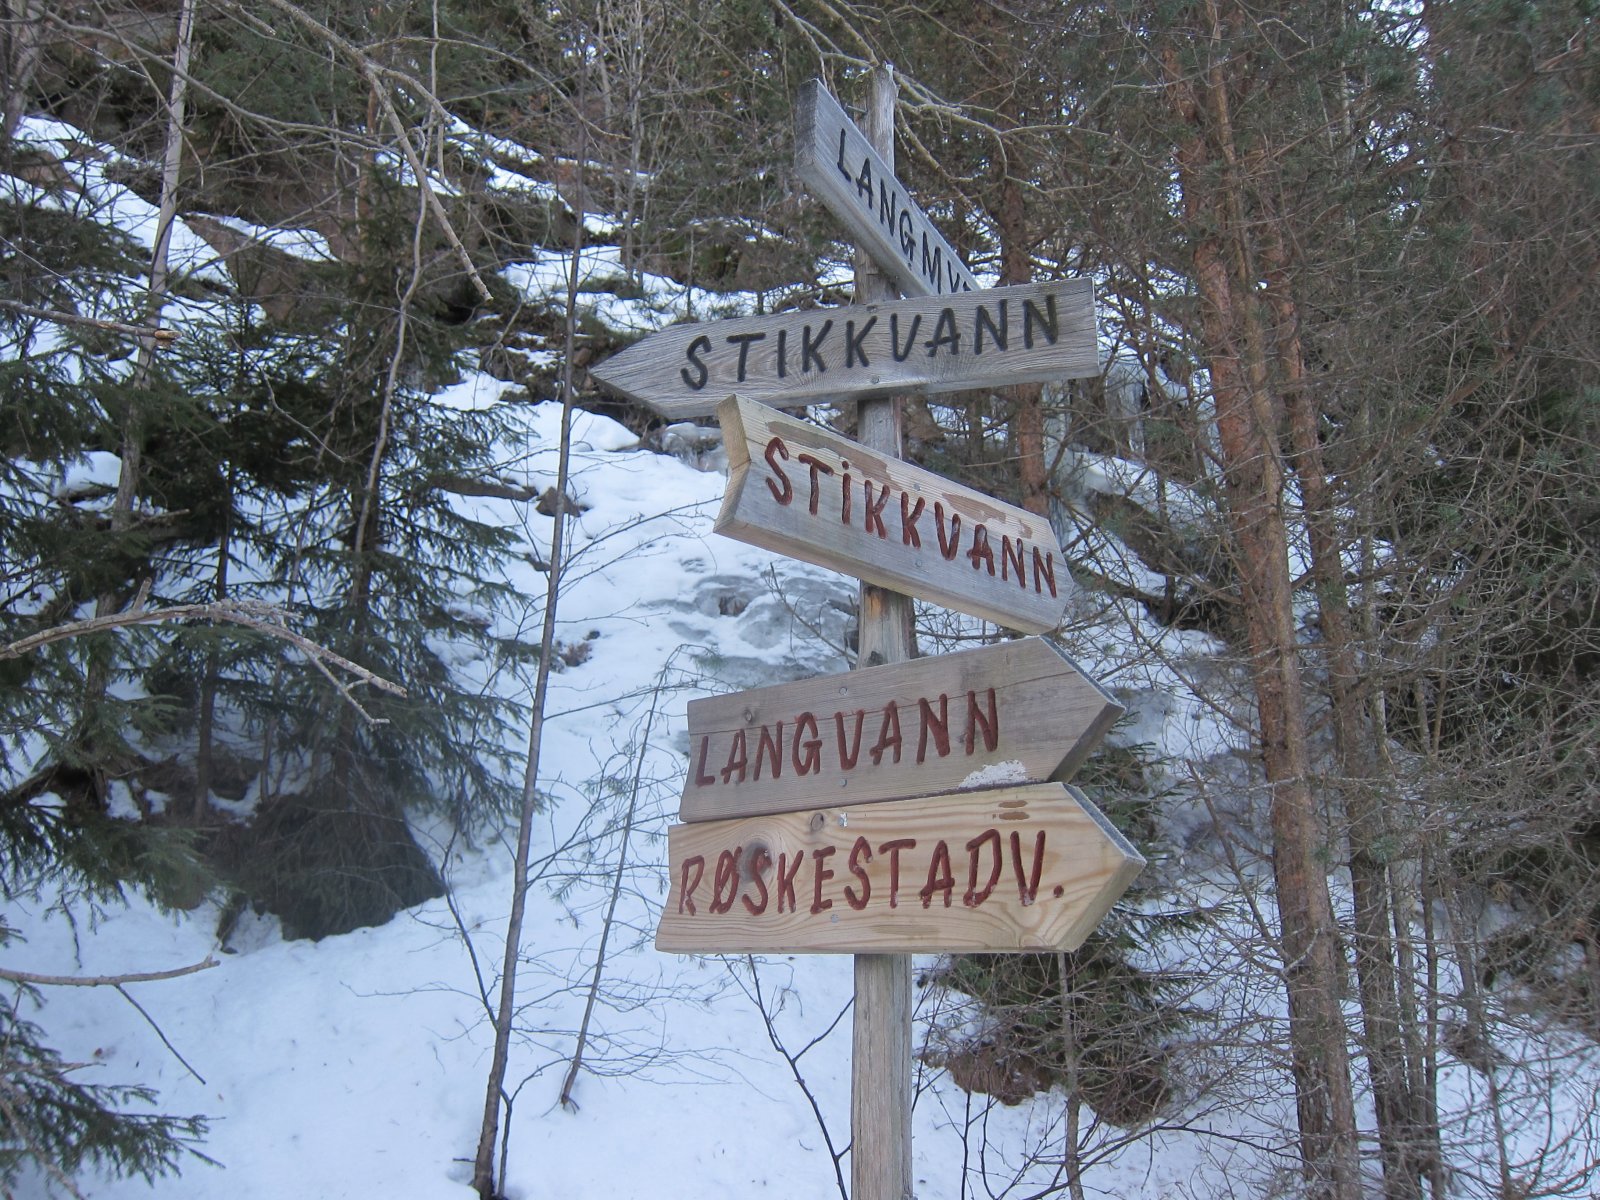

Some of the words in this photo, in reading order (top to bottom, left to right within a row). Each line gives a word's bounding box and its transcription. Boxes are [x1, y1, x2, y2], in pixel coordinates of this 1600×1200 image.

[680, 295, 1058, 391] STIKKVANN
[695, 688, 998, 787] LANGVANN
[678, 828, 1065, 917] RØSKESTADV.
